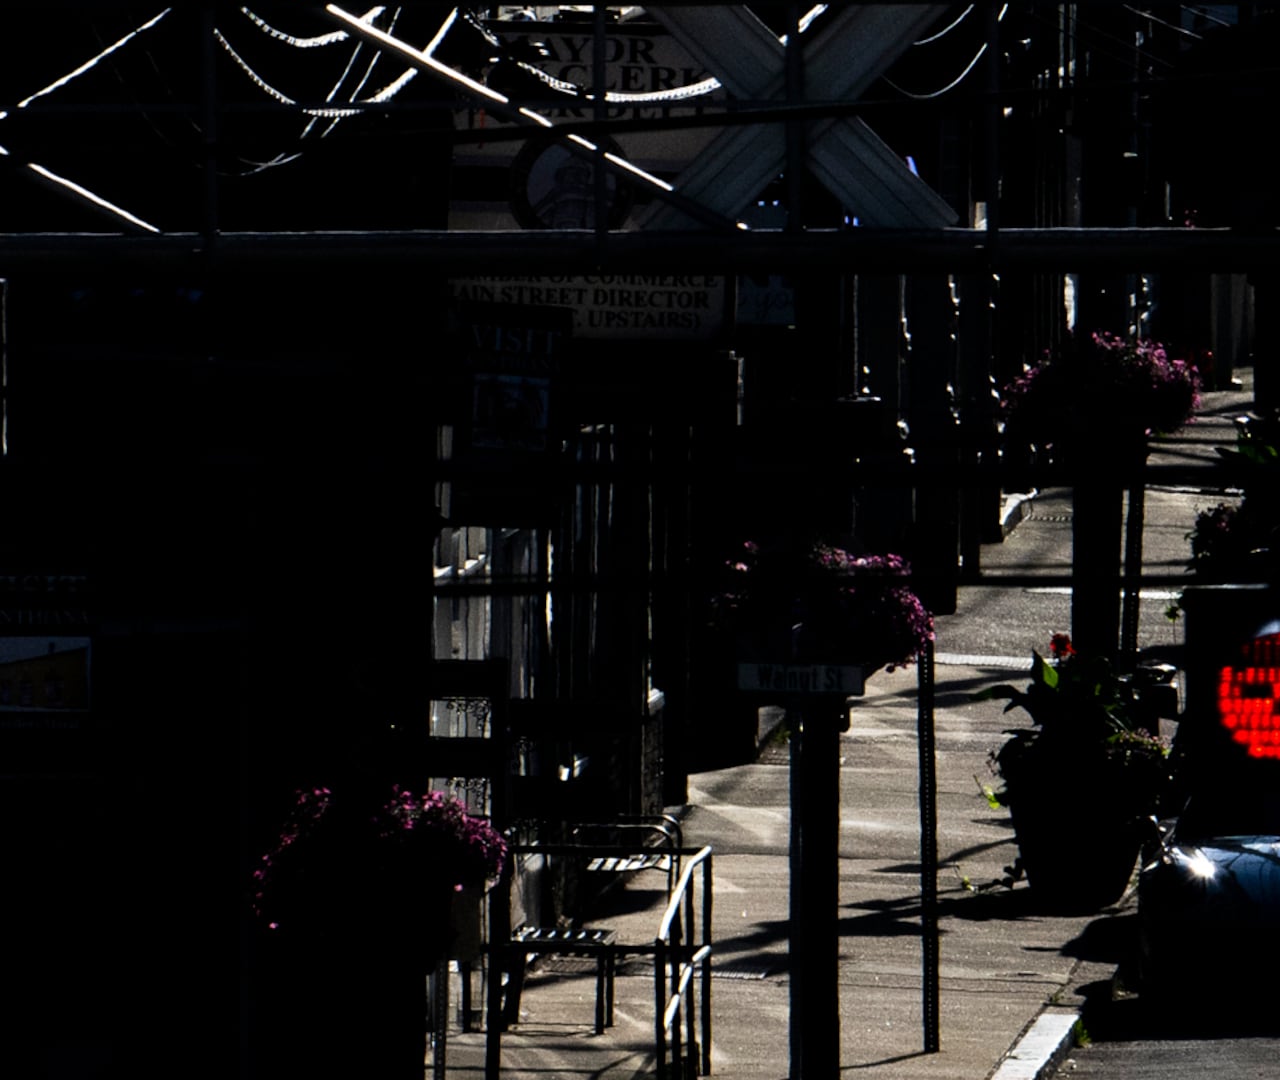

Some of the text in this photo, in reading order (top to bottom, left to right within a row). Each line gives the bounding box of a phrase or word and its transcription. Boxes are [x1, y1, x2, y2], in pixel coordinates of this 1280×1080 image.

[520, 36, 656, 64] AYOR
[500, 286, 588, 307] STREET
[592, 288, 709, 309] DIRECTOR
[824, 666, 844, 690] St
